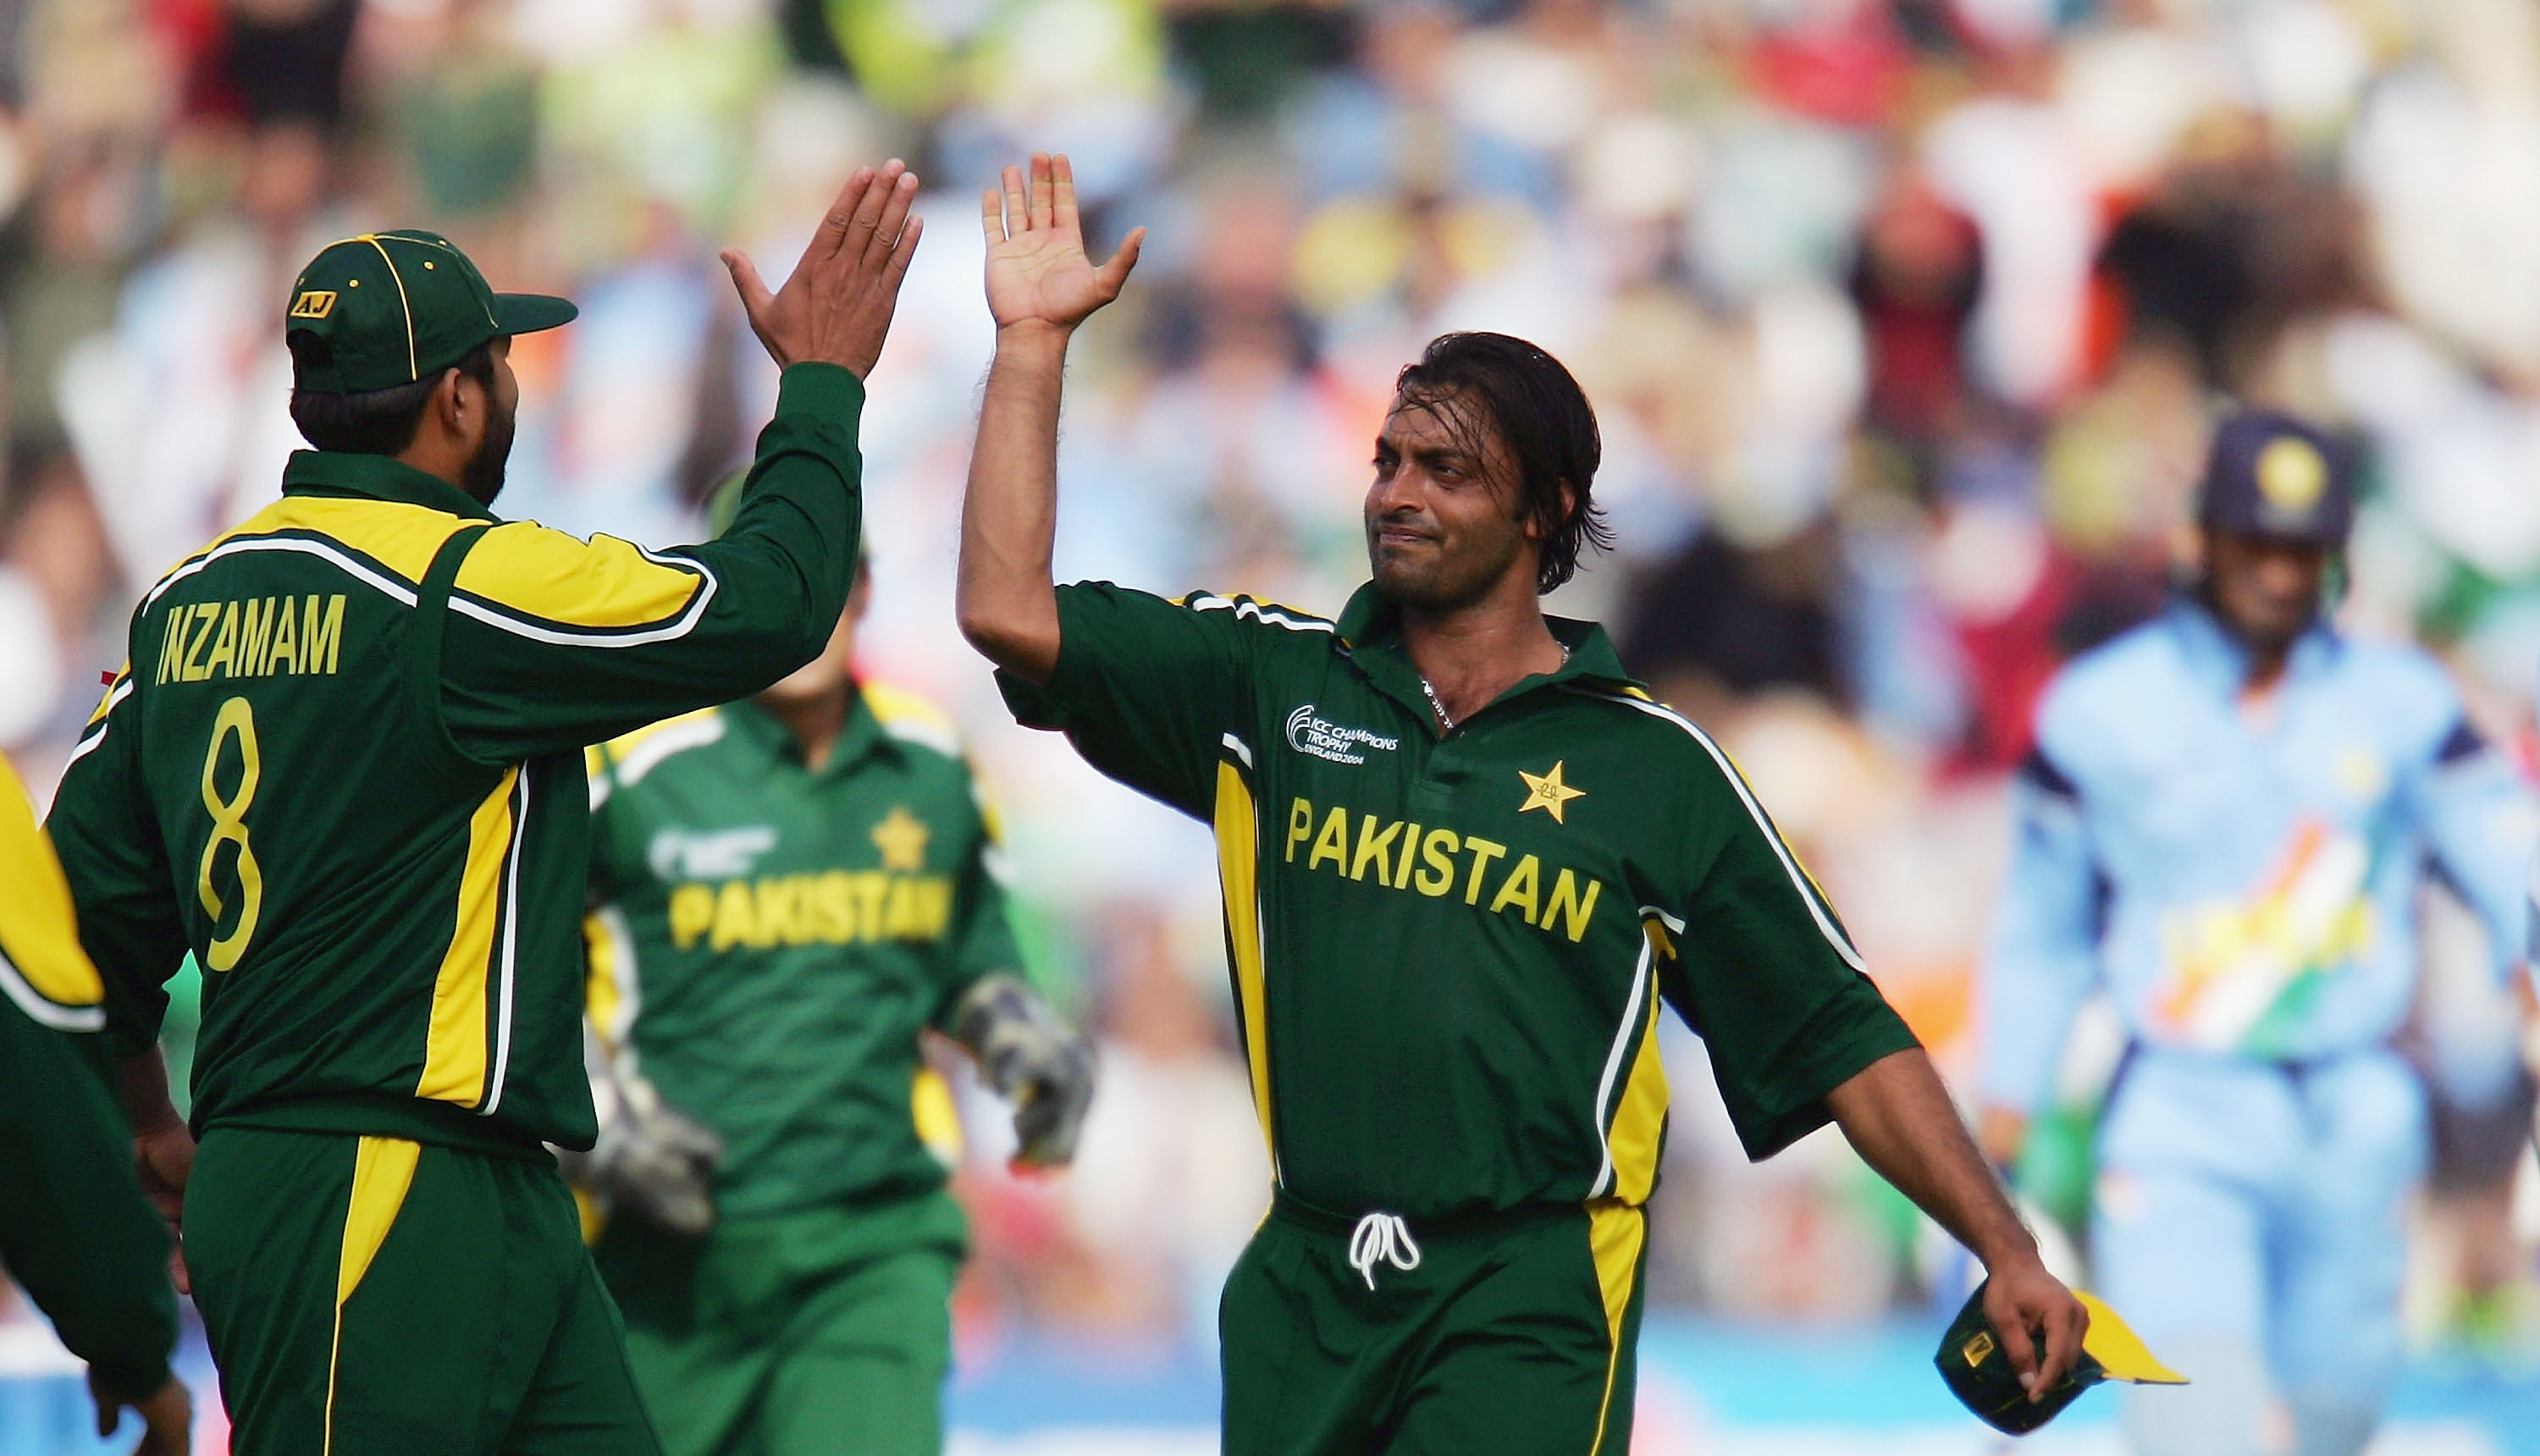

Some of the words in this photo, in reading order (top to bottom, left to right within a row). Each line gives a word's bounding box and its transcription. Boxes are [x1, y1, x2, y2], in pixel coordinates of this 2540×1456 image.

[295, 295, 332, 313] AJ
[155, 593, 347, 687] INZAMAM
[1306, 729, 1352, 753] TROPHY
[1311, 717, 1334, 734] ICC
[1331, 727, 1399, 751] CHAMPIONS
[198, 696, 262, 972] 8
[1284, 796, 1602, 944] PAKISTAN
